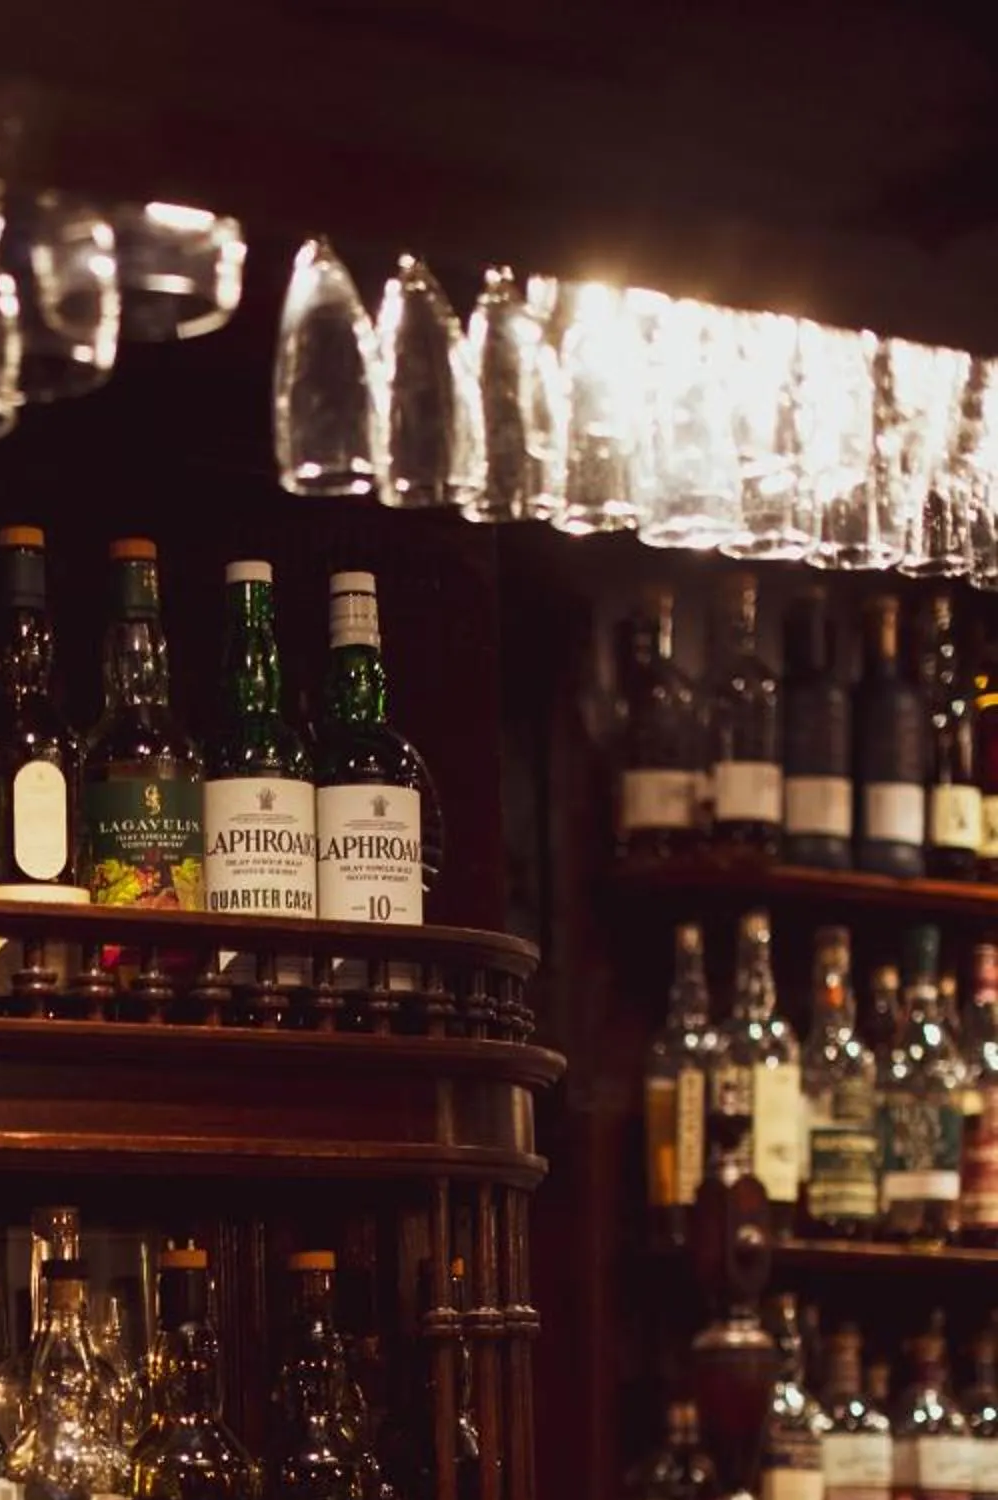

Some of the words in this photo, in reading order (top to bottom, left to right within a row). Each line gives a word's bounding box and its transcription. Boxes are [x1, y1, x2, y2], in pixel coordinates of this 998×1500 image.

[99, 819, 200, 834] LAGAVULIN
[210, 888, 281, 911] QUARTER
[285, 889, 313, 911] CASK
[369, 895, 391, 921] 10
